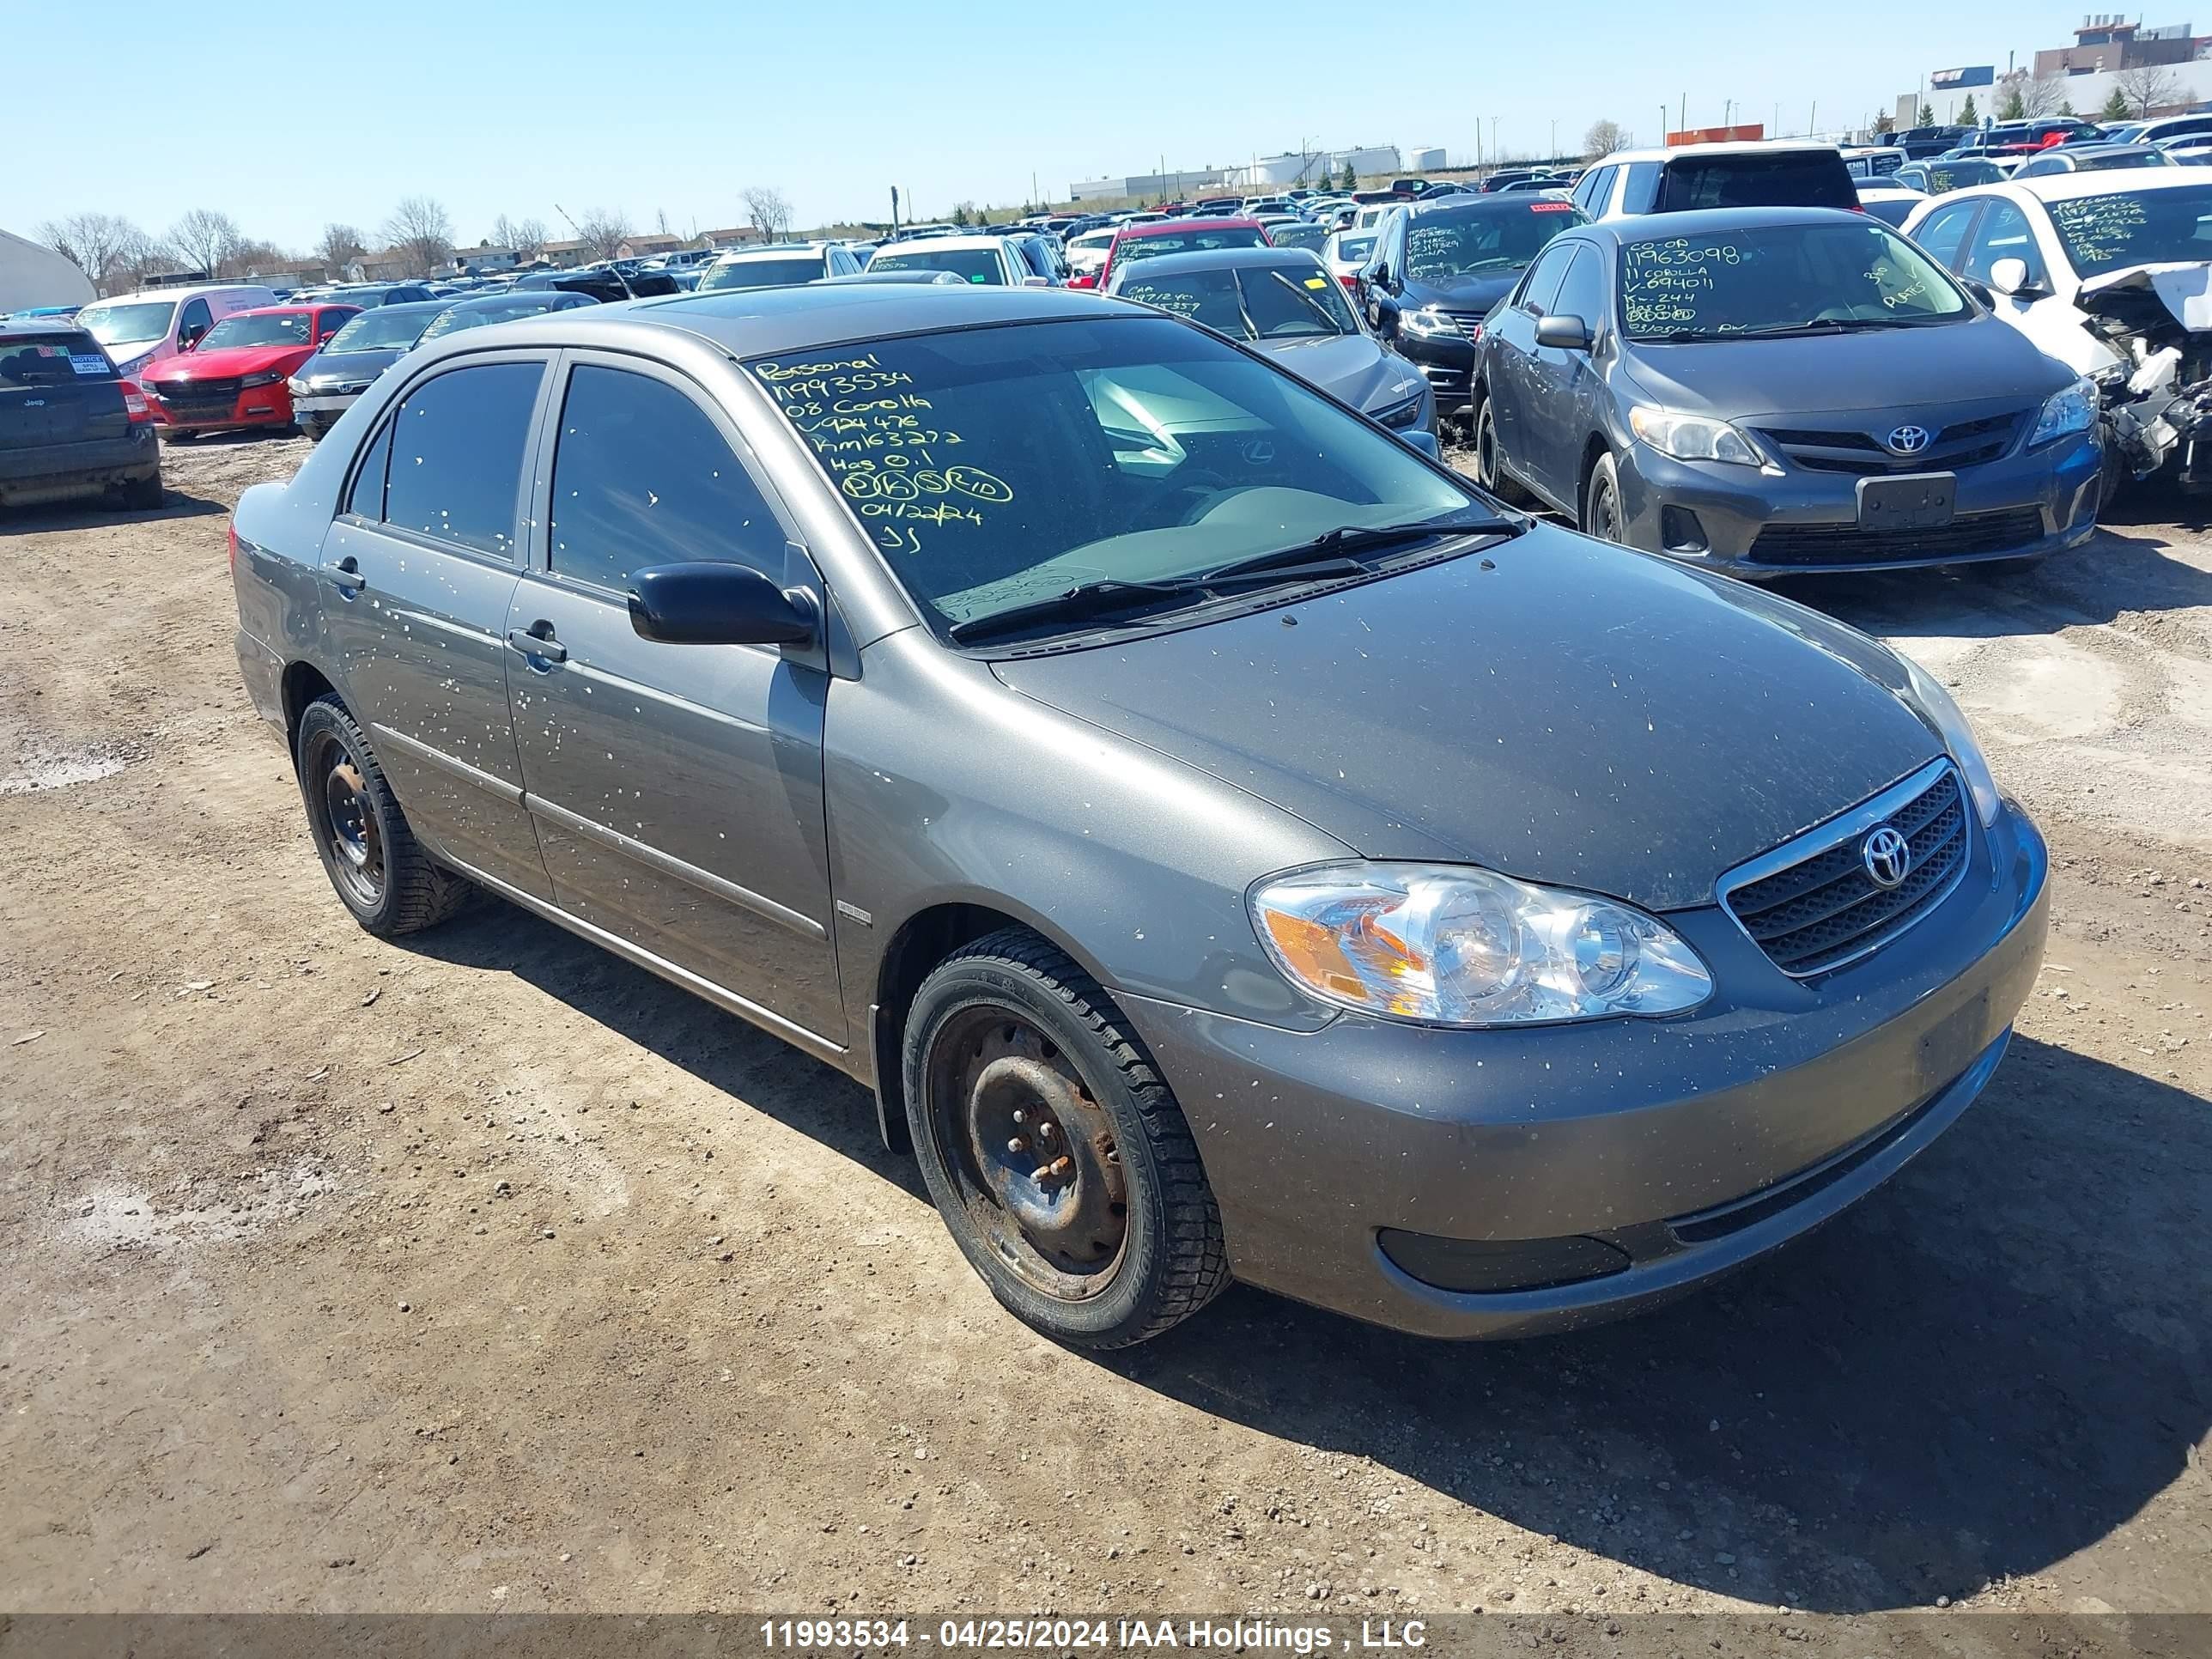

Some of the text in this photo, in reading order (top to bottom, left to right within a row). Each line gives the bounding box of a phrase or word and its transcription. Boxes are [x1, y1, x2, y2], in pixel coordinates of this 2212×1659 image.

[1626, 246, 1740, 266] 11963098
[1626, 267, 1707, 280] 11 COROLLA
[755, 353, 882, 380] Personal
[785, 393, 933, 418] 08 Corolla
[830, 458, 877, 471] Has
[860, 501, 984, 527] 04/22/24
